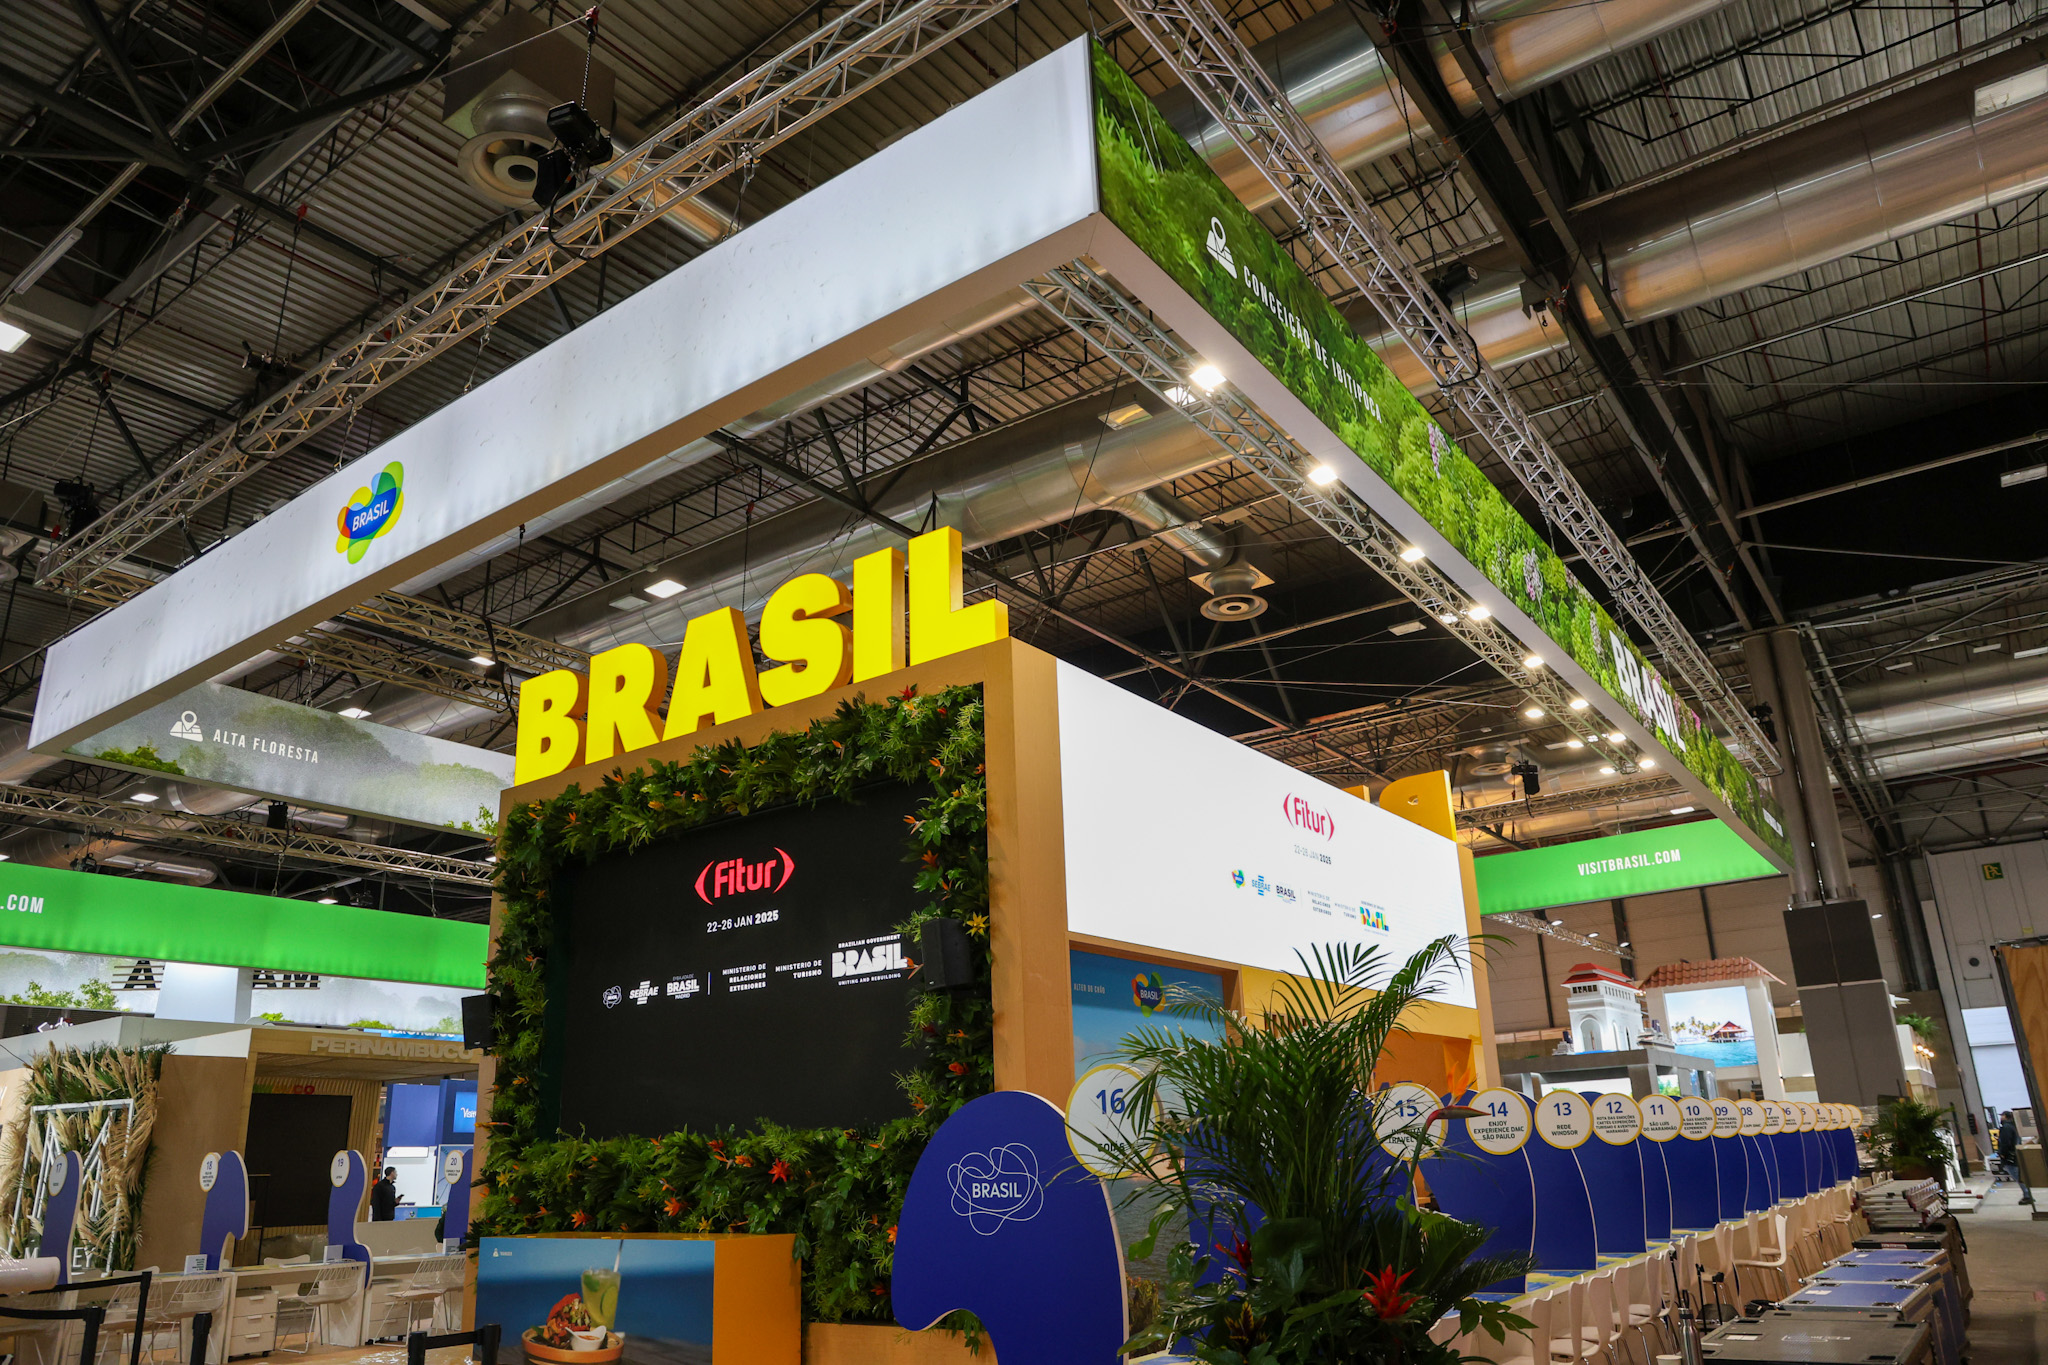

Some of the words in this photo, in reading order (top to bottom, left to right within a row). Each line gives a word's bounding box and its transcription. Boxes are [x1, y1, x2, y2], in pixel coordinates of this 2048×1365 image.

[1243, 265, 1310, 350] CONCEIÇÃO
[1314, 338, 1329, 369] DE
[1331, 357, 1382, 424] IBITIPOCA
[352, 500, 389, 532] BRASIL
[514, 525, 1009, 786] BRASIL
[1609, 629, 1686, 753] BRASIL
[213, 729, 246, 748] ALTA
[253, 738, 318, 764] FLORESTA
[1320, 853, 1332, 865] 2025
[1578, 848, 1682, 876] VISITBRASIL.COM
[1276, 885, 1296, 899] BRASIL
[706, 918, 733, 933] 22-26
[734, 915, 753, 928] JAN
[755, 909, 779, 925] 2025
[838, 940, 866, 949] BRAZILIAN
[866, 933, 901, 945] GOVERNMENT
[775, 961, 812, 973] MINISTERIO
[813, 959, 822, 967] DE
[832, 942, 908, 979] BRASIL
[722, 964, 757, 976] MINISTERIO
[792, 969, 822, 979] TURISMO
[729, 972, 767, 984] RELACIONES
[838, 978, 859, 986] UNITING
[871, 973, 901, 982] REBUILDING
[628, 985, 660, 999] SEBRAE
[666, 978, 700, 993] BRASIL
[729, 981, 767, 993] EXTERIORES
[1139, 989, 1160, 1001] BRASIL
[311, 1035, 474, 1060] PERNAMBUCO
[1096, 1088, 1126, 1115] 16
[1395, 1099, 1418, 1117] 15
[1605, 1101, 1624, 1114] 12
[1487, 1101, 1509, 1118] 14
[1553, 1102, 1572, 1116] 13
[1649, 1104, 1665, 1116] 11
[1685, 1105, 1701, 1116] 10
[1714, 1106, 1728, 1117] 09
[1740, 1106, 1753, 1116] 08
[1473, 1127, 1510, 1135] EXPERIENCE
[1482, 1133, 1495, 1141] SÃO
[1551, 1129, 1579, 1137] WINDSOR
[450, 1157, 458, 1166] 20
[972, 1182, 1022, 1198] BRASIL
